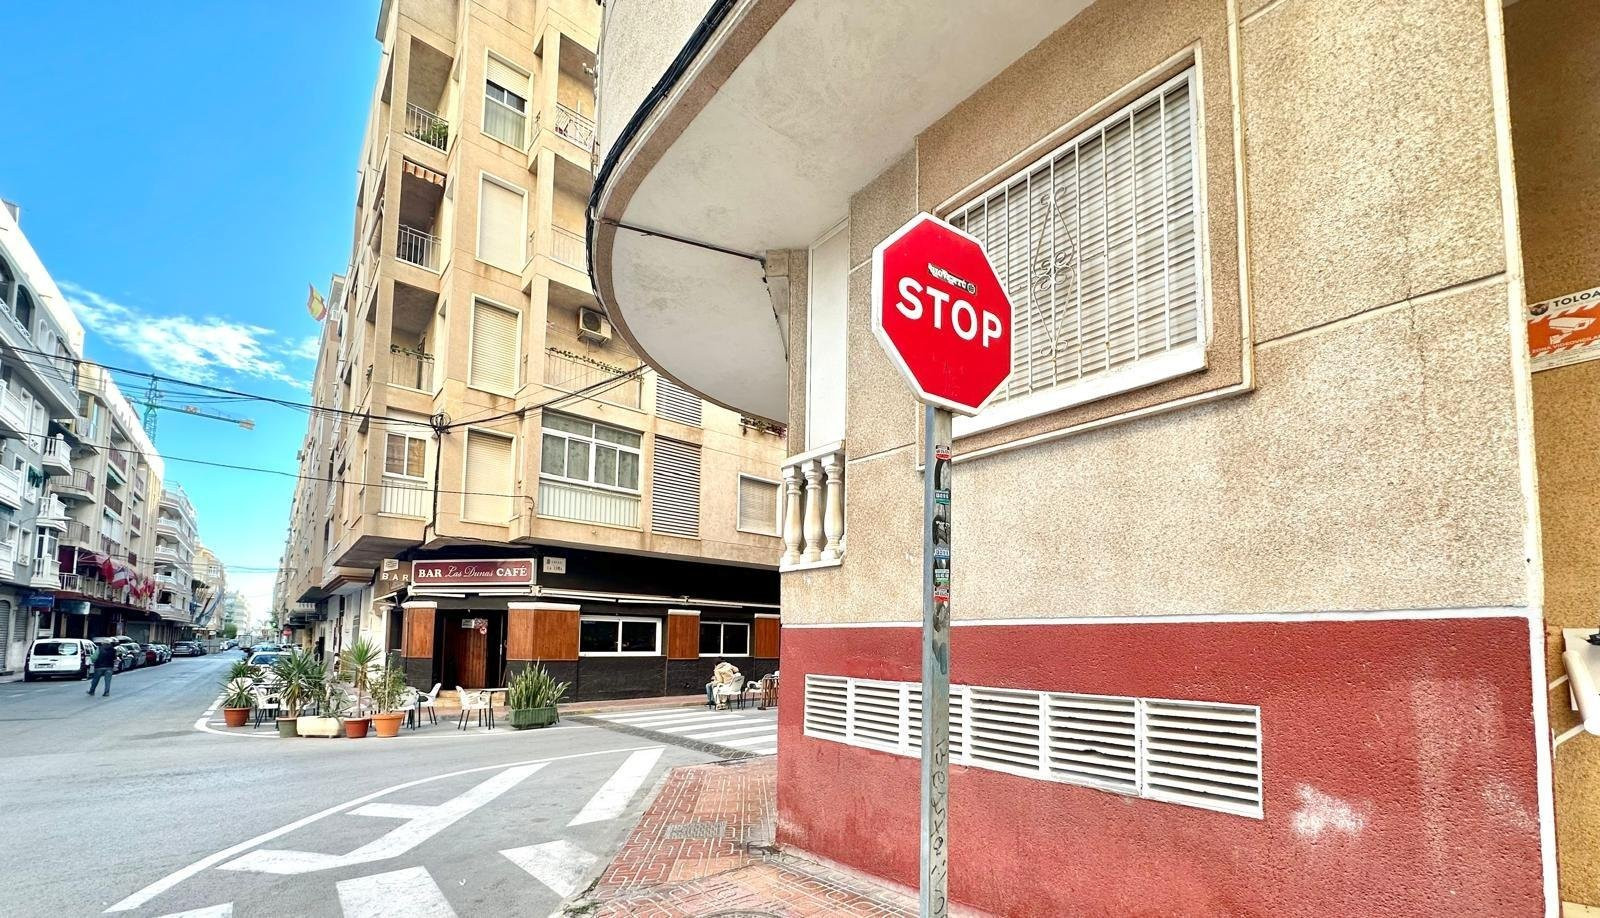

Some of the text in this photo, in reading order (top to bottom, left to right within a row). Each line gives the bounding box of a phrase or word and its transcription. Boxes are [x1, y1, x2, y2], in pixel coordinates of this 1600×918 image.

[896, 277, 1003, 348] STOP
[382, 572, 409, 582] BAR
[418, 565, 528, 578] BAR Las Dunas CAFÉ
